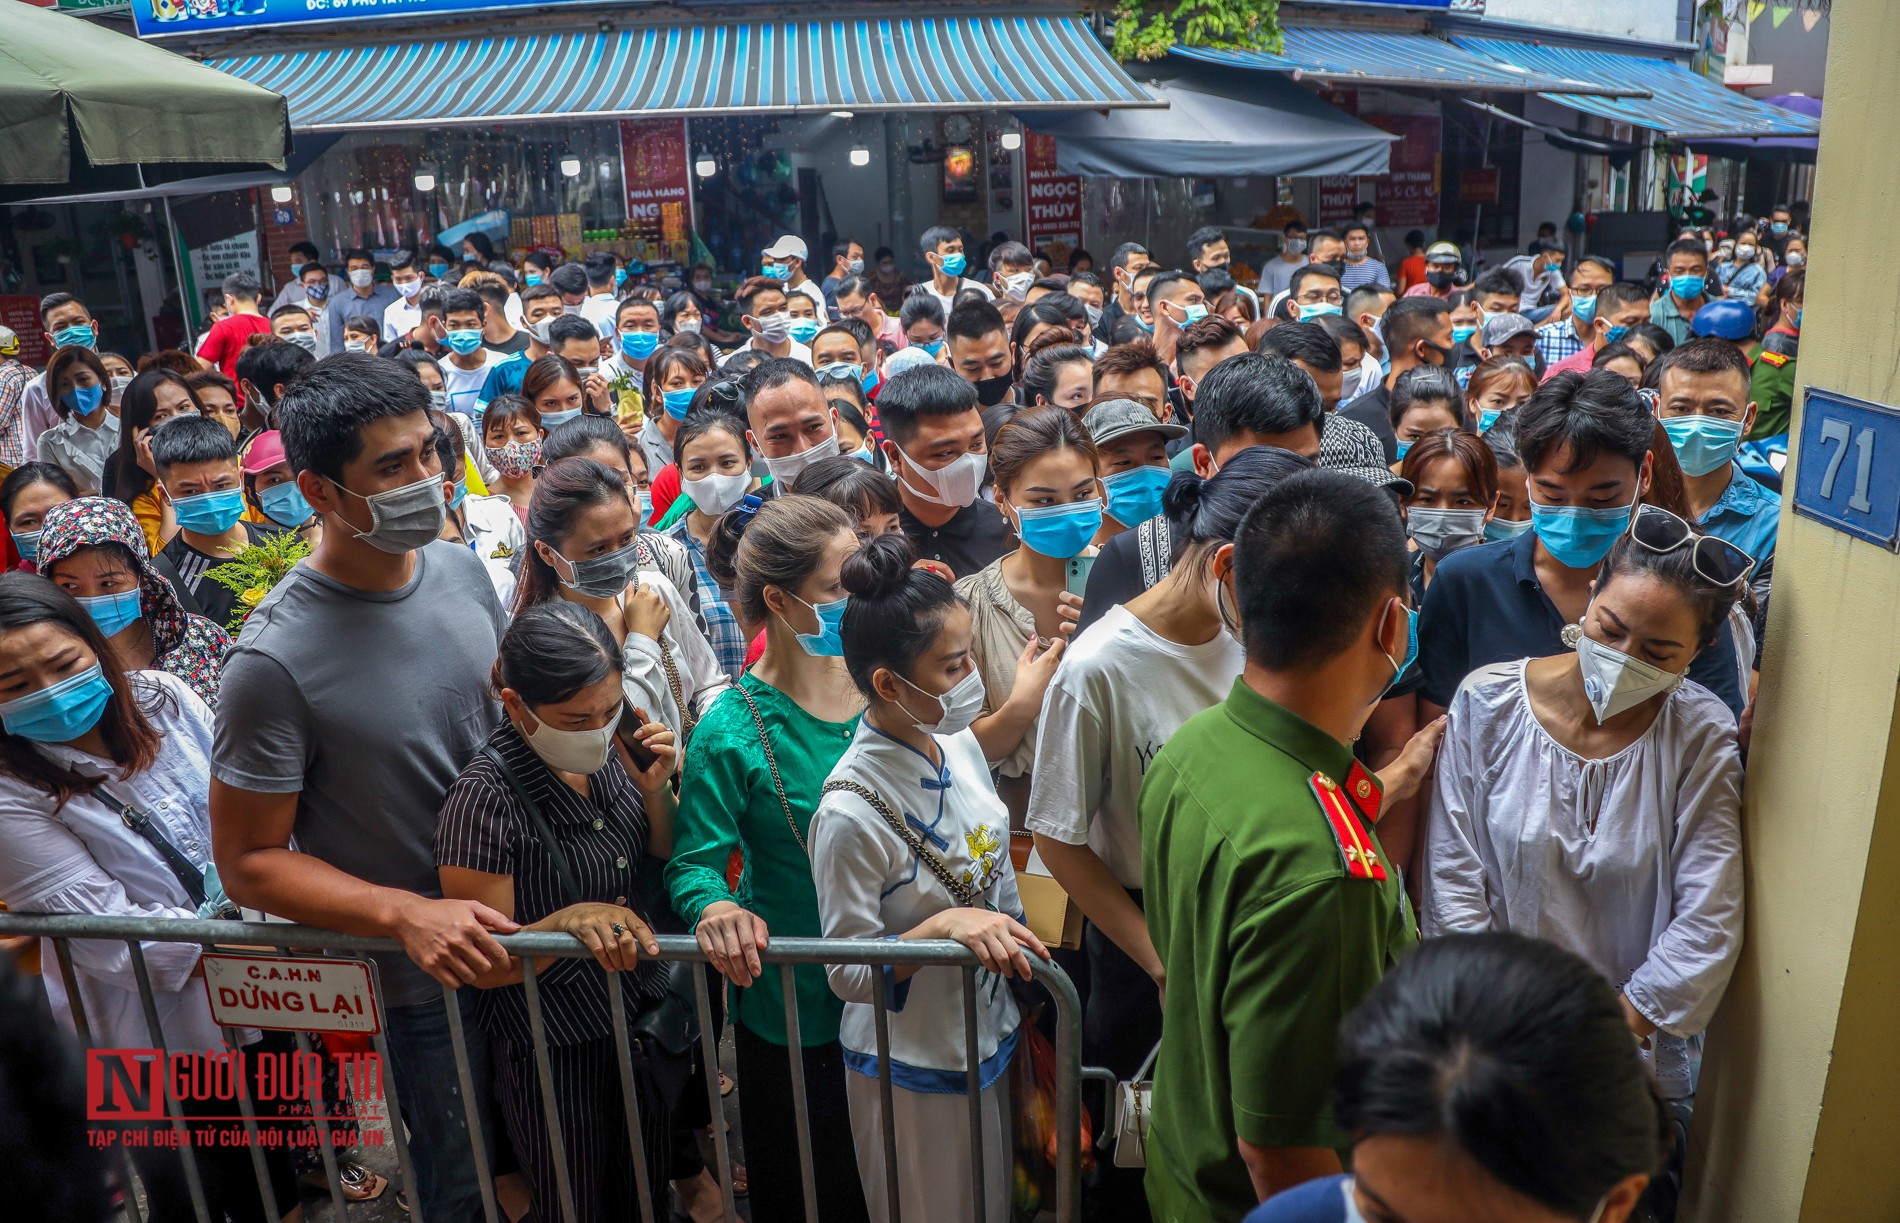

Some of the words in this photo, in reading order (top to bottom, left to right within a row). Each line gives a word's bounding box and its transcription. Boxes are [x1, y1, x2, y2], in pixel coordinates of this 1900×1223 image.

[631, 188, 653, 198] NHÀ
[656, 187, 685, 197] HÀNG
[1031, 182, 1077, 199] NGỌC
[277, 211, 290, 223] 69
[632, 202, 660, 219] NG
[1820, 416, 1876, 514] 71
[247, 966, 322, 983] C.A.H.N
[218, 982, 304, 1012] DỪNG
[309, 993, 364, 1019] LẠI
